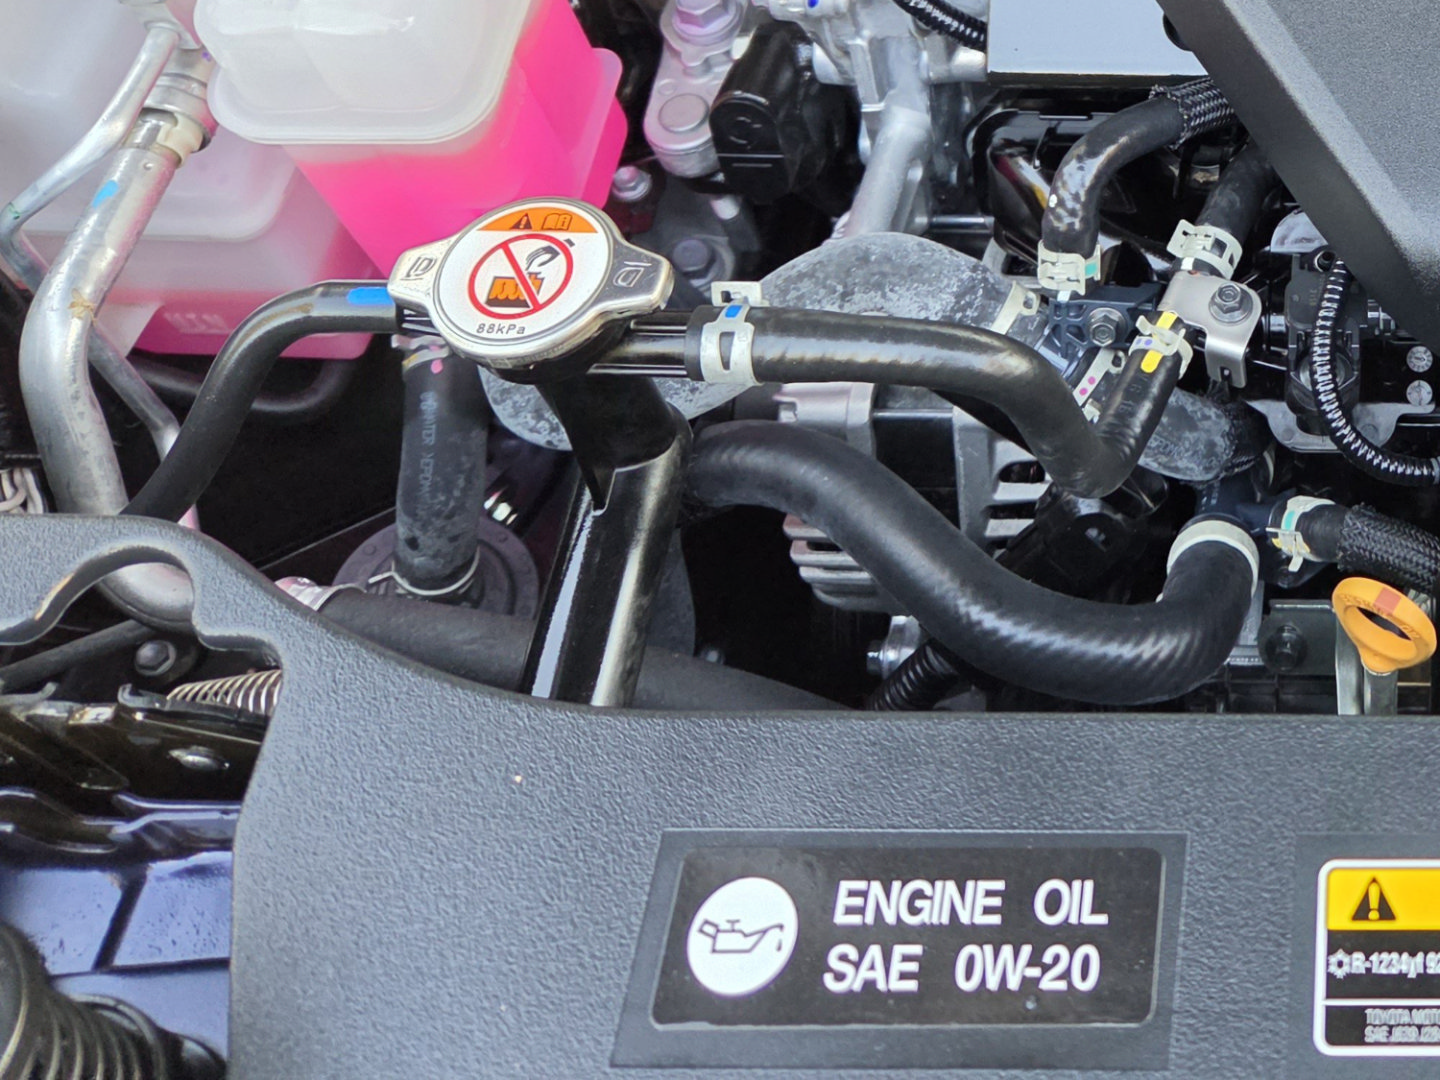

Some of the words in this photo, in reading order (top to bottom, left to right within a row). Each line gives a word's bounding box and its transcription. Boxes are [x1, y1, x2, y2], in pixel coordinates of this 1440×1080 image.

[476, 323, 526, 336] 88kPa
[832, 879, 1006, 926] ENGINE
[1033, 878, 1109, 926] OIL
[822, 943, 924, 993] SAE
[954, 943, 1101, 992] 0W-20
[1351, 951, 1424, 978] R-1234yf
[1364, 1008, 1411, 1025] TOYOTA
